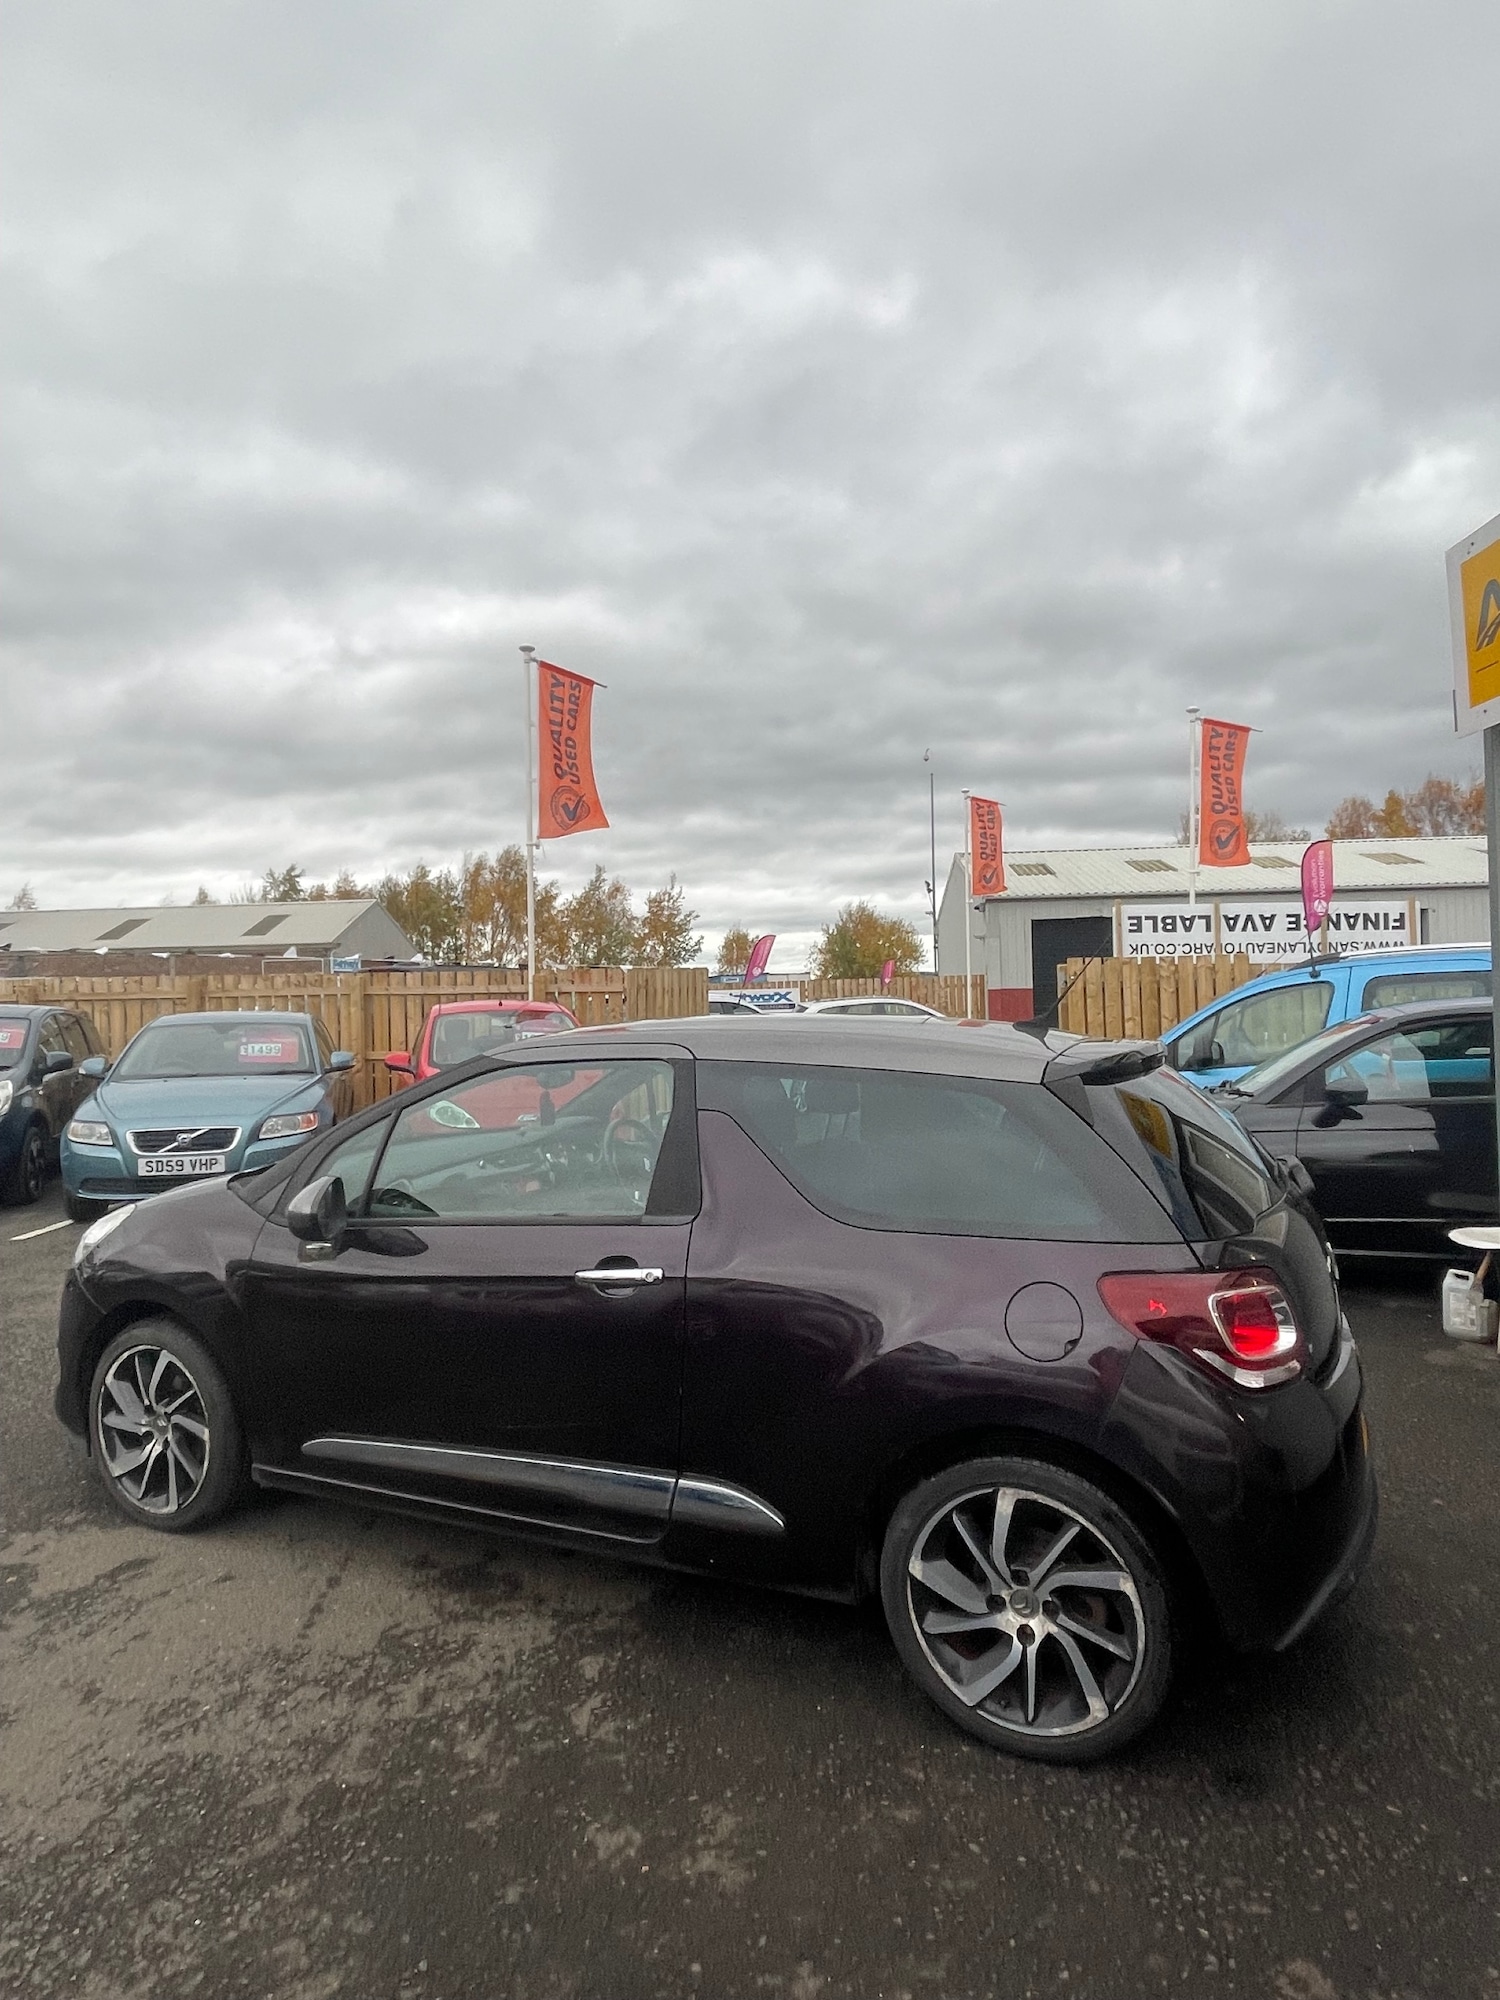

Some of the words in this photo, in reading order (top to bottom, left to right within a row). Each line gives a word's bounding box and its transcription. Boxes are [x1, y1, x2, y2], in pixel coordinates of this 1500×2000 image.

[548, 672, 569, 780] QUALITY
[566, 680, 582, 731] CARS
[564, 737, 581, 785] USED
[1208, 727, 1229, 815] QUALITY
[1222, 730, 1238, 772] CARS
[986, 804, 996, 830] CARS
[1225, 776, 1239, 816] USED
[975, 802, 990, 861] QUALITY
[988, 833, 997, 862] USED
[1317, 850, 1326, 898] Warranties
[1127, 914, 1277, 933] AVALABLE
[1286, 912, 1406, 931] FINANE
[145, 1160, 184, 1173] SD59
[190, 1158, 219, 1171] VHP
